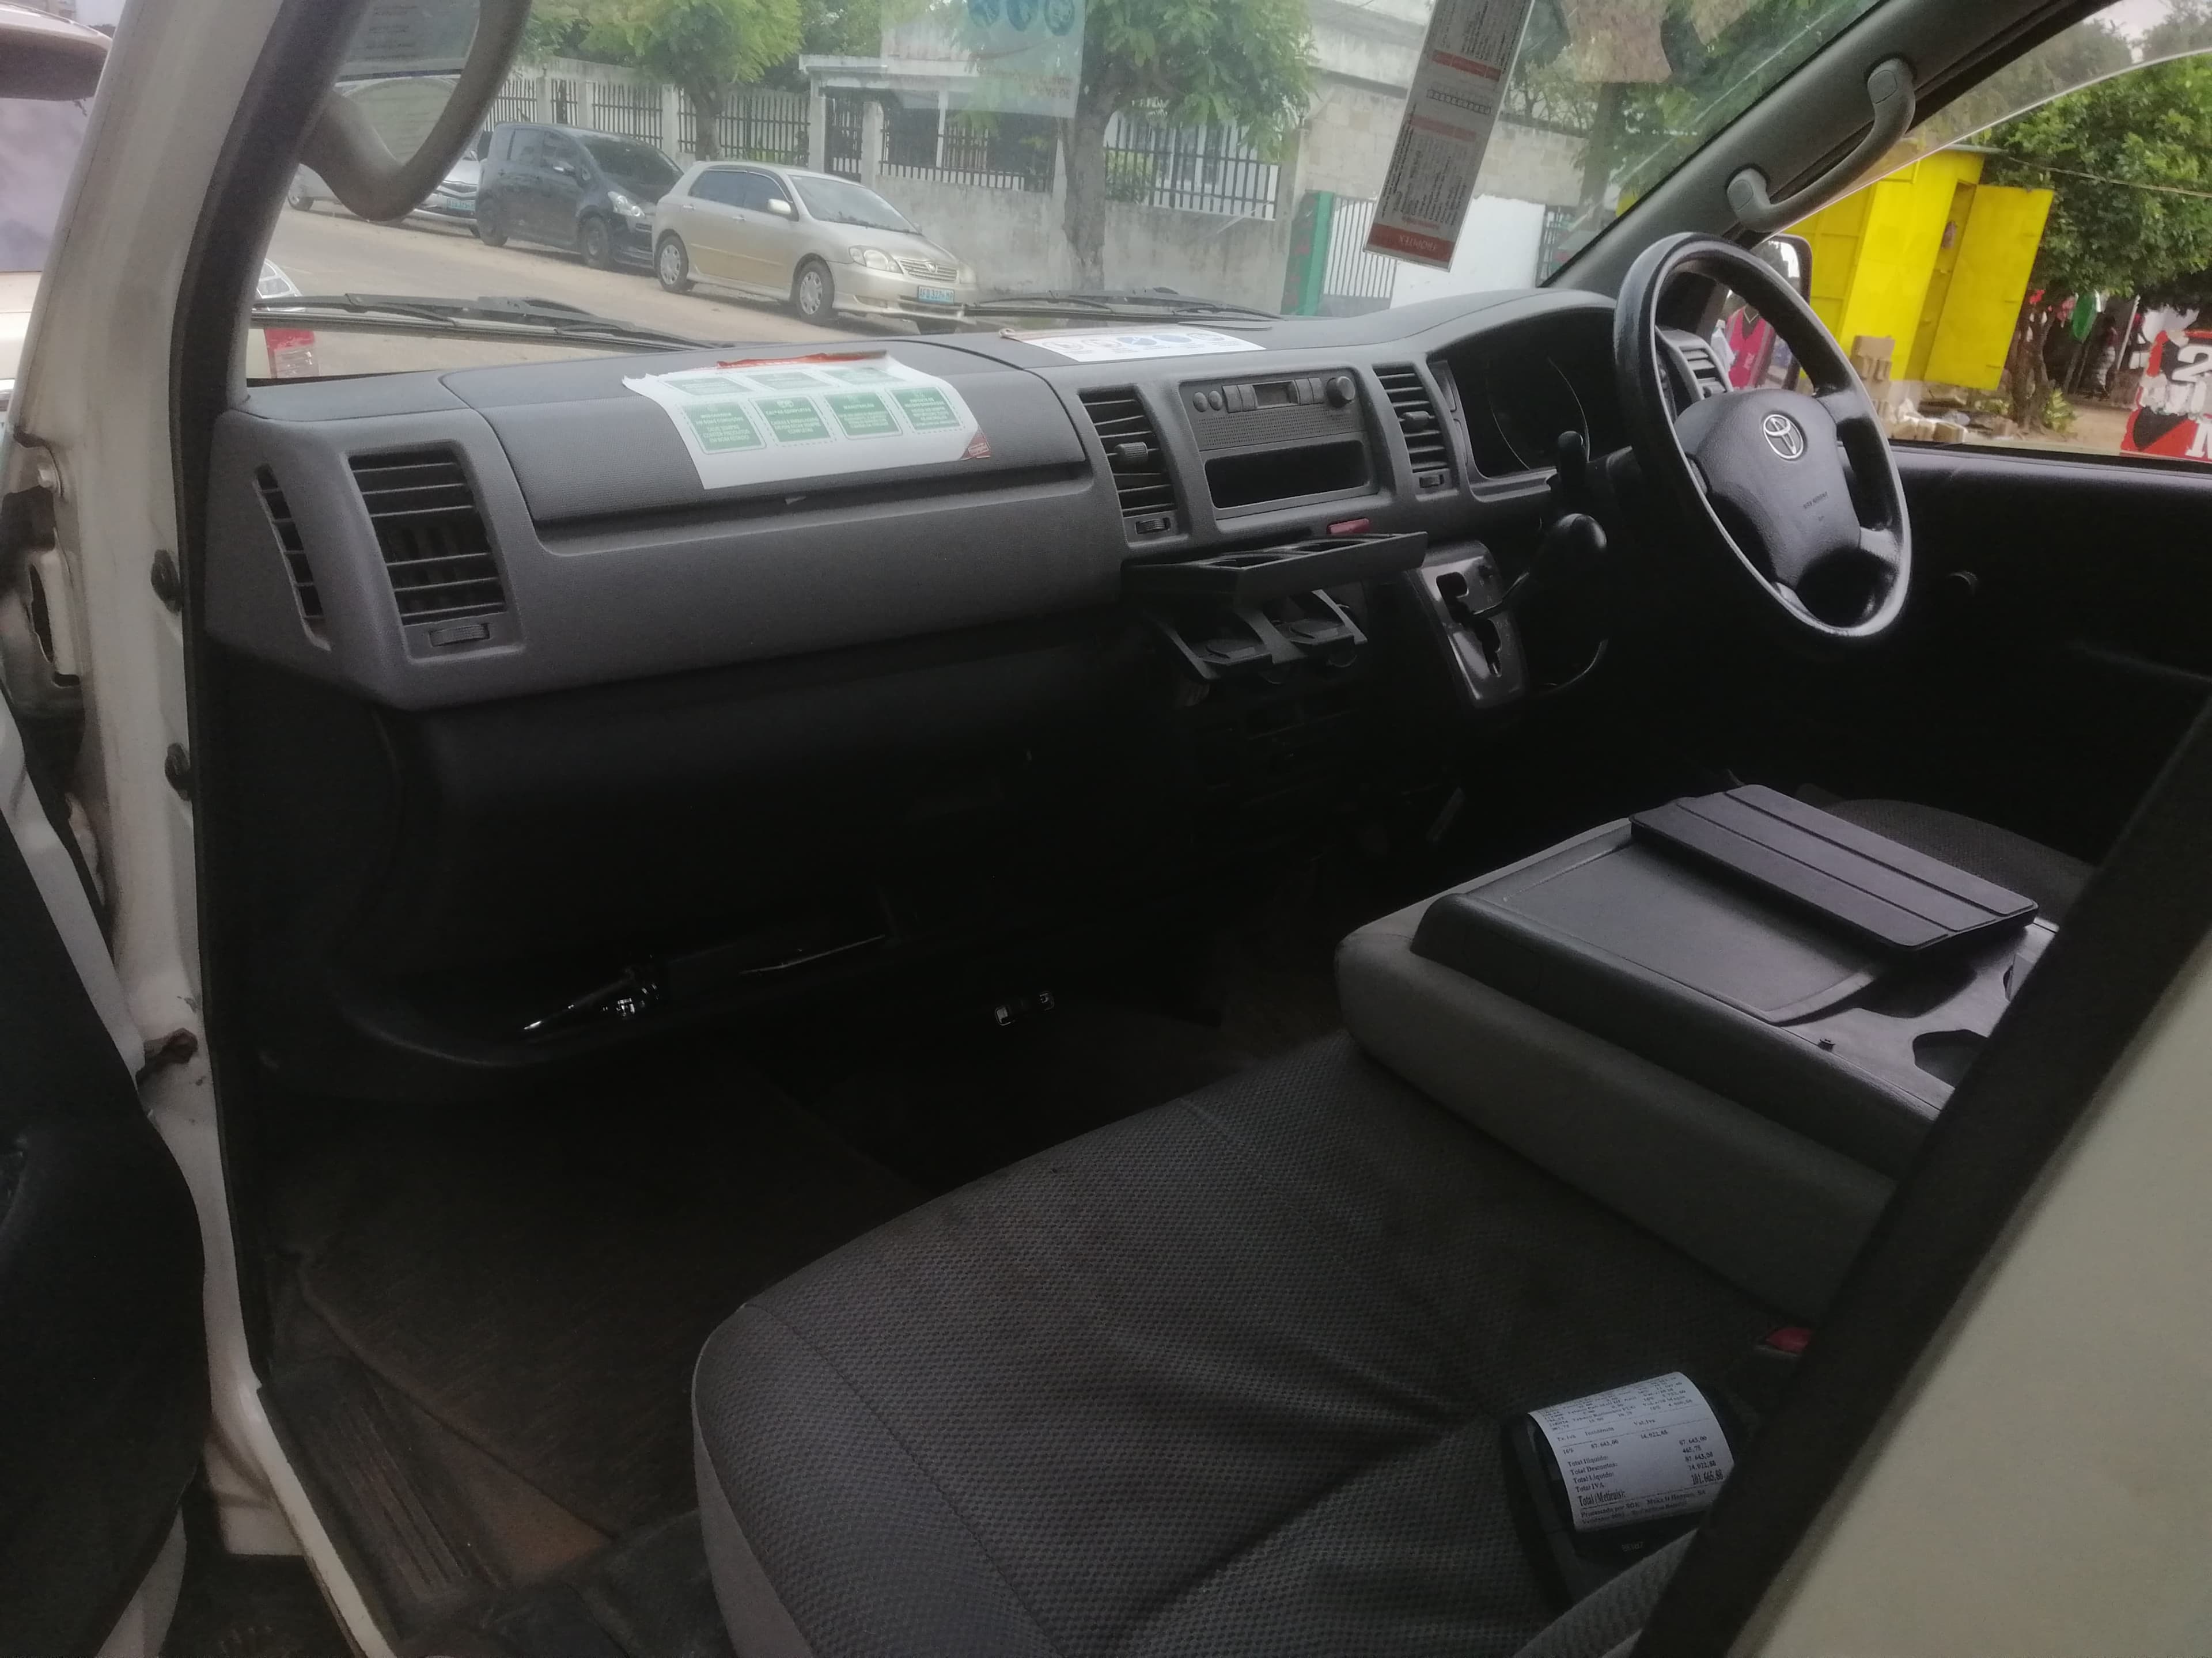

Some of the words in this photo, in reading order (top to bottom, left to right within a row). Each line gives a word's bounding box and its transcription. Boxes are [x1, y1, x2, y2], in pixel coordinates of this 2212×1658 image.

[1567, 1459, 1583, 1467] Total
[1570, 1467, 1586, 1475] Total
[1573, 1476, 1589, 1484] Total
[1577, 1495, 1594, 1507] Total
